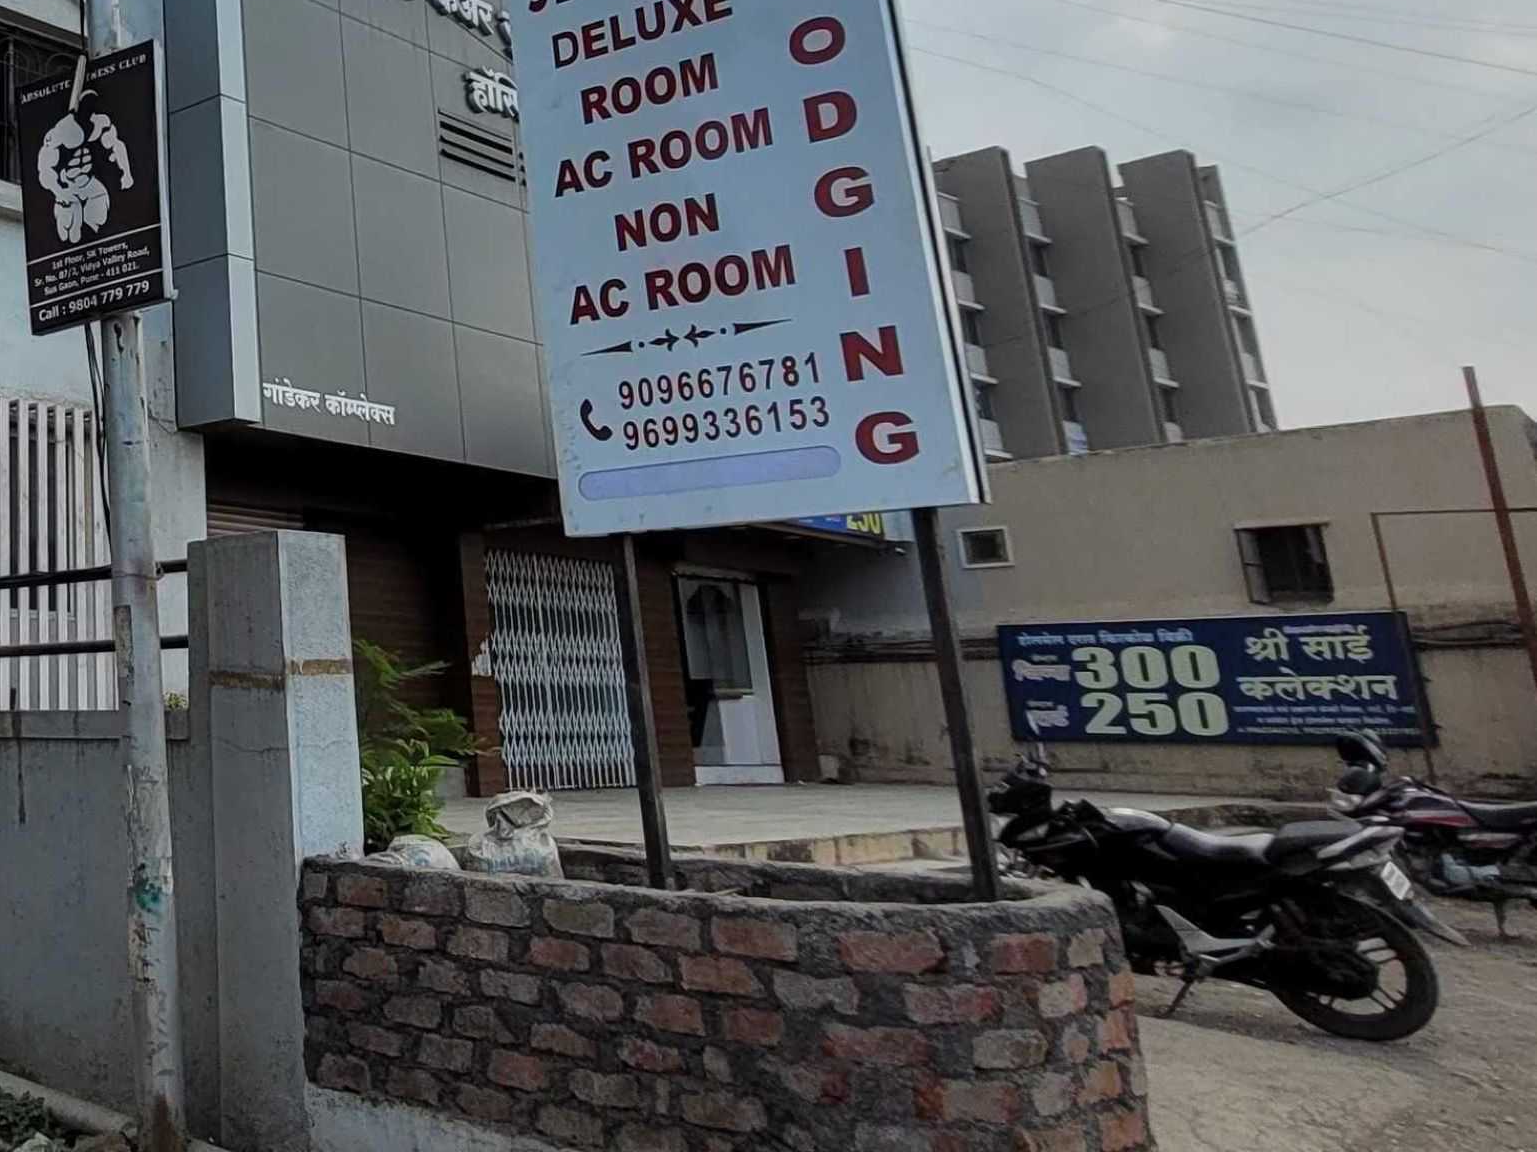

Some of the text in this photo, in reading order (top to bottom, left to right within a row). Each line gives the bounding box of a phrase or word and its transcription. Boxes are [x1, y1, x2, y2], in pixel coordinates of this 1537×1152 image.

[118, 53, 148, 70] CLUB
[580, 52, 719, 125] ROOM
[554, 107, 774, 198] AC ROOM
[614, 192, 721, 252] NON
[38, 304, 60, 321] Call
[68, 294, 98, 314] 9804
[100, 287, 124, 305] 779
[125, 279, 150, 297] 779
[569, 244, 797, 326] AC ROOM
[617, 351, 822, 410] 9096676781
[622, 395, 830, 451] 9699336153
[1071, 644, 1221, 689] 300
[1244, 624, 1374, 664] श्री साई
[1236, 666, 1399, 702] कलेक्शन
[1080, 691, 1230, 737] 250
